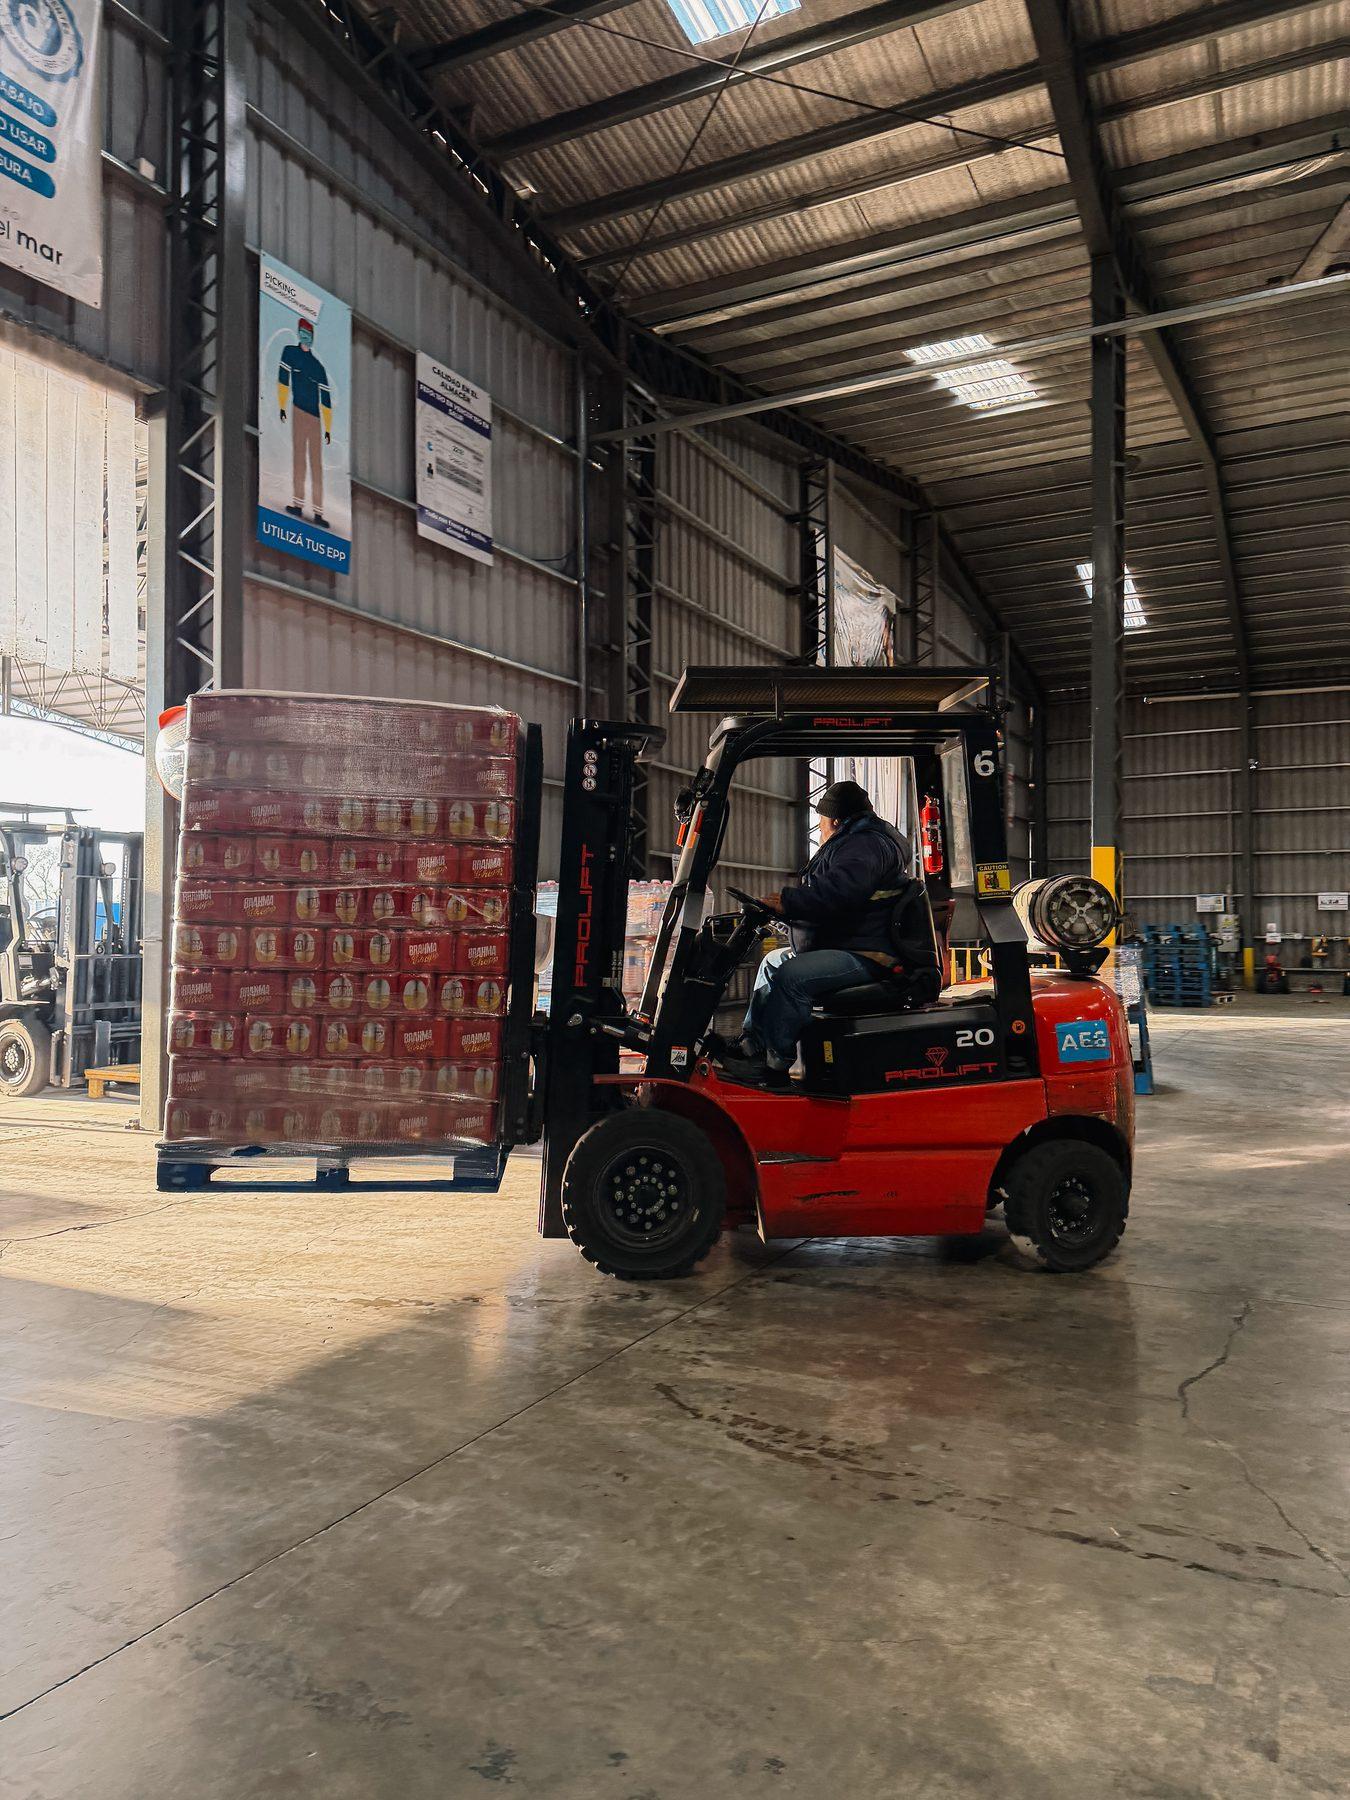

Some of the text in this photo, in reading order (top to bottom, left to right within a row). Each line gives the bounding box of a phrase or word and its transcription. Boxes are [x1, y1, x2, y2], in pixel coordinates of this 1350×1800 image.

[10, 123, 48, 155] USAR
[17, 230, 63, 265] mar
[264, 272, 297, 297] PICKING
[262, 521, 346, 562] UTILIZÁ TUS EPP
[813, 717, 892, 727] PROLIFT
[974, 750, 995, 777] 6
[472, 857, 504, 871] BRAHMA
[574, 843, 594, 987] PROLIFT
[408, 942, 437, 956] BRAHMA
[467, 945, 497, 959] BRAHMA
[403, 1029, 433, 1044] BRAHMA
[461, 1031, 491, 1046] BRAHMA
[955, 1028, 995, 1048] 20
[884, 1062, 998, 1082] PROLIFT
